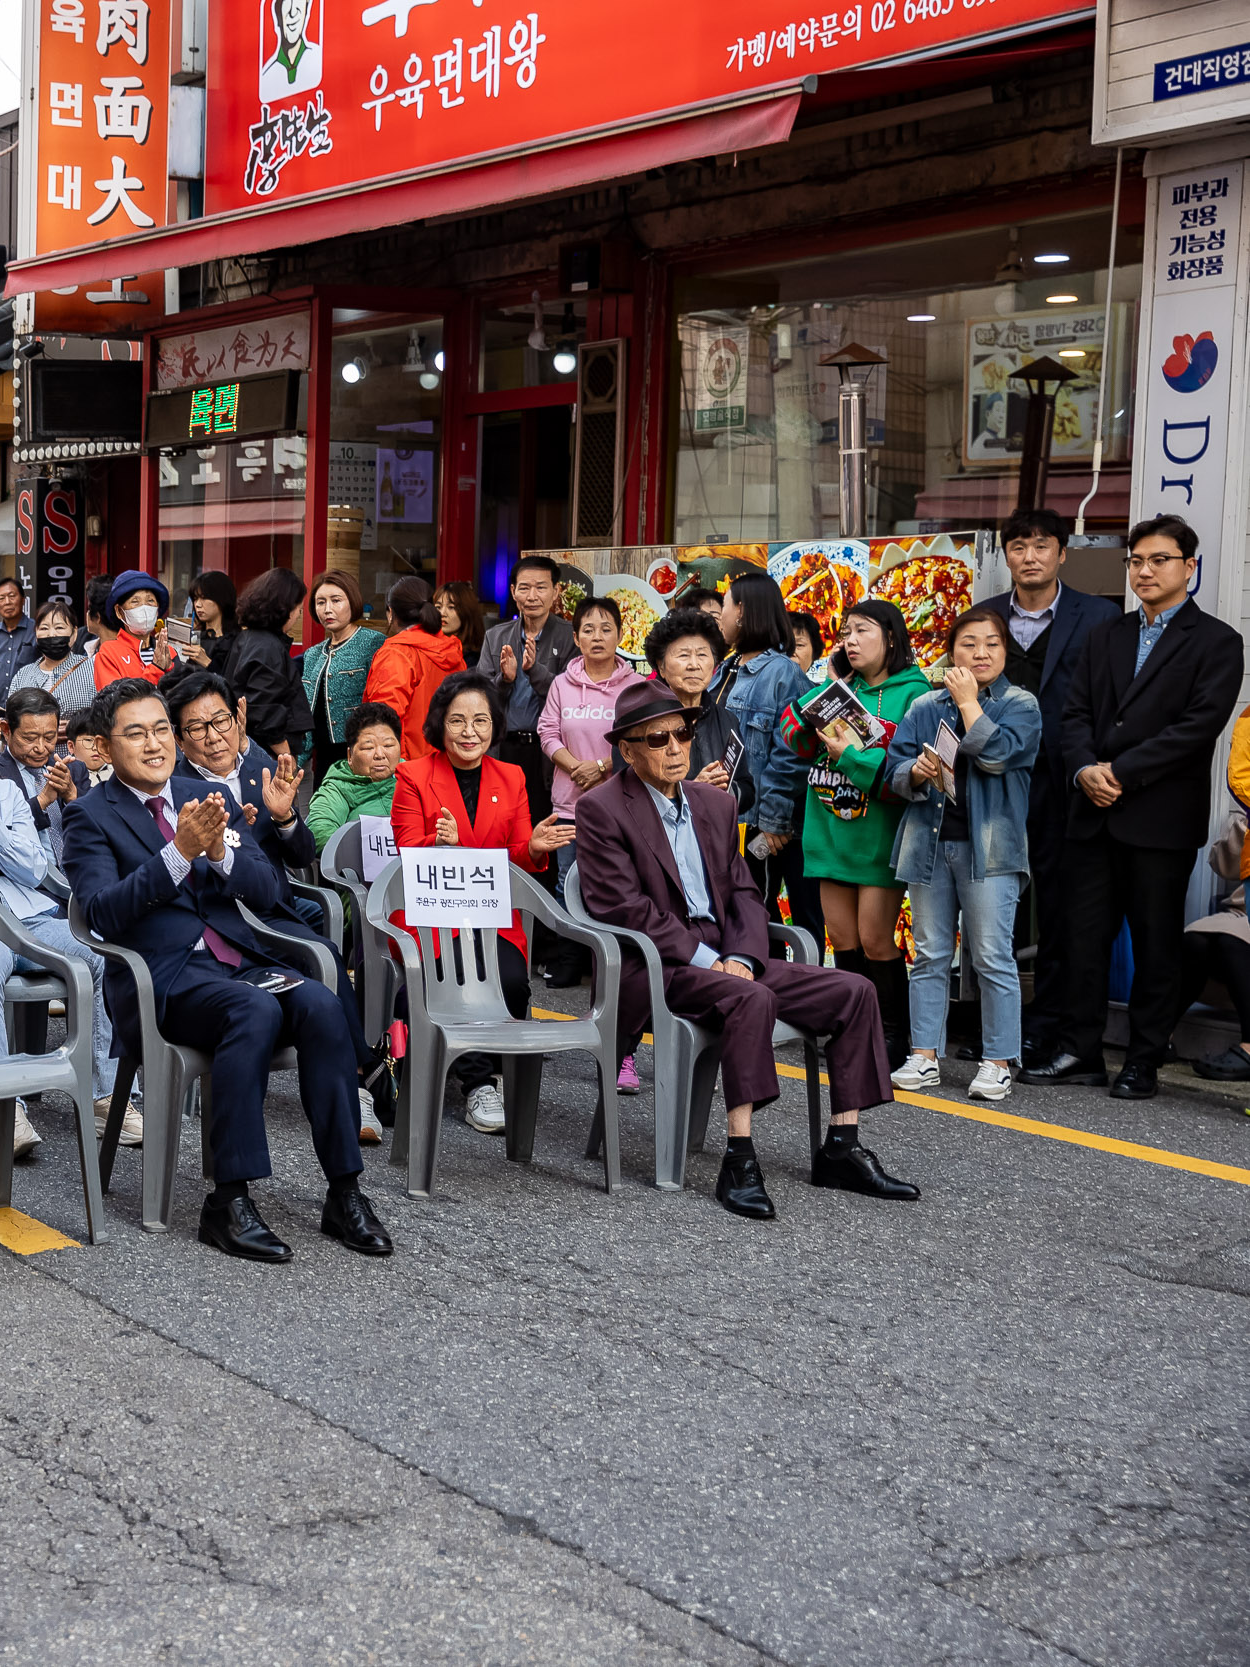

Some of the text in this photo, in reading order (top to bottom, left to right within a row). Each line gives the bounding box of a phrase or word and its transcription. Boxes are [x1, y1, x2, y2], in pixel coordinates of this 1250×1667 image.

[725, 5, 862, 72] 가맹/예약문의
[871, 0, 897, 32] 02
[361, 12, 547, 132] 우육면대왕
[1172, 177, 1229, 206] 피부과
[1179, 205, 1217, 230] 전용
[1169, 229, 1226, 256] 기능성
[1167, 255, 1224, 281] 화장품
[340, 447, 354, 459] 10
[561, 705, 615, 720] adida
[416, 864, 495, 890] 내빈석
[415, 897, 499, 908] 추윤구 광진구의회 의장
